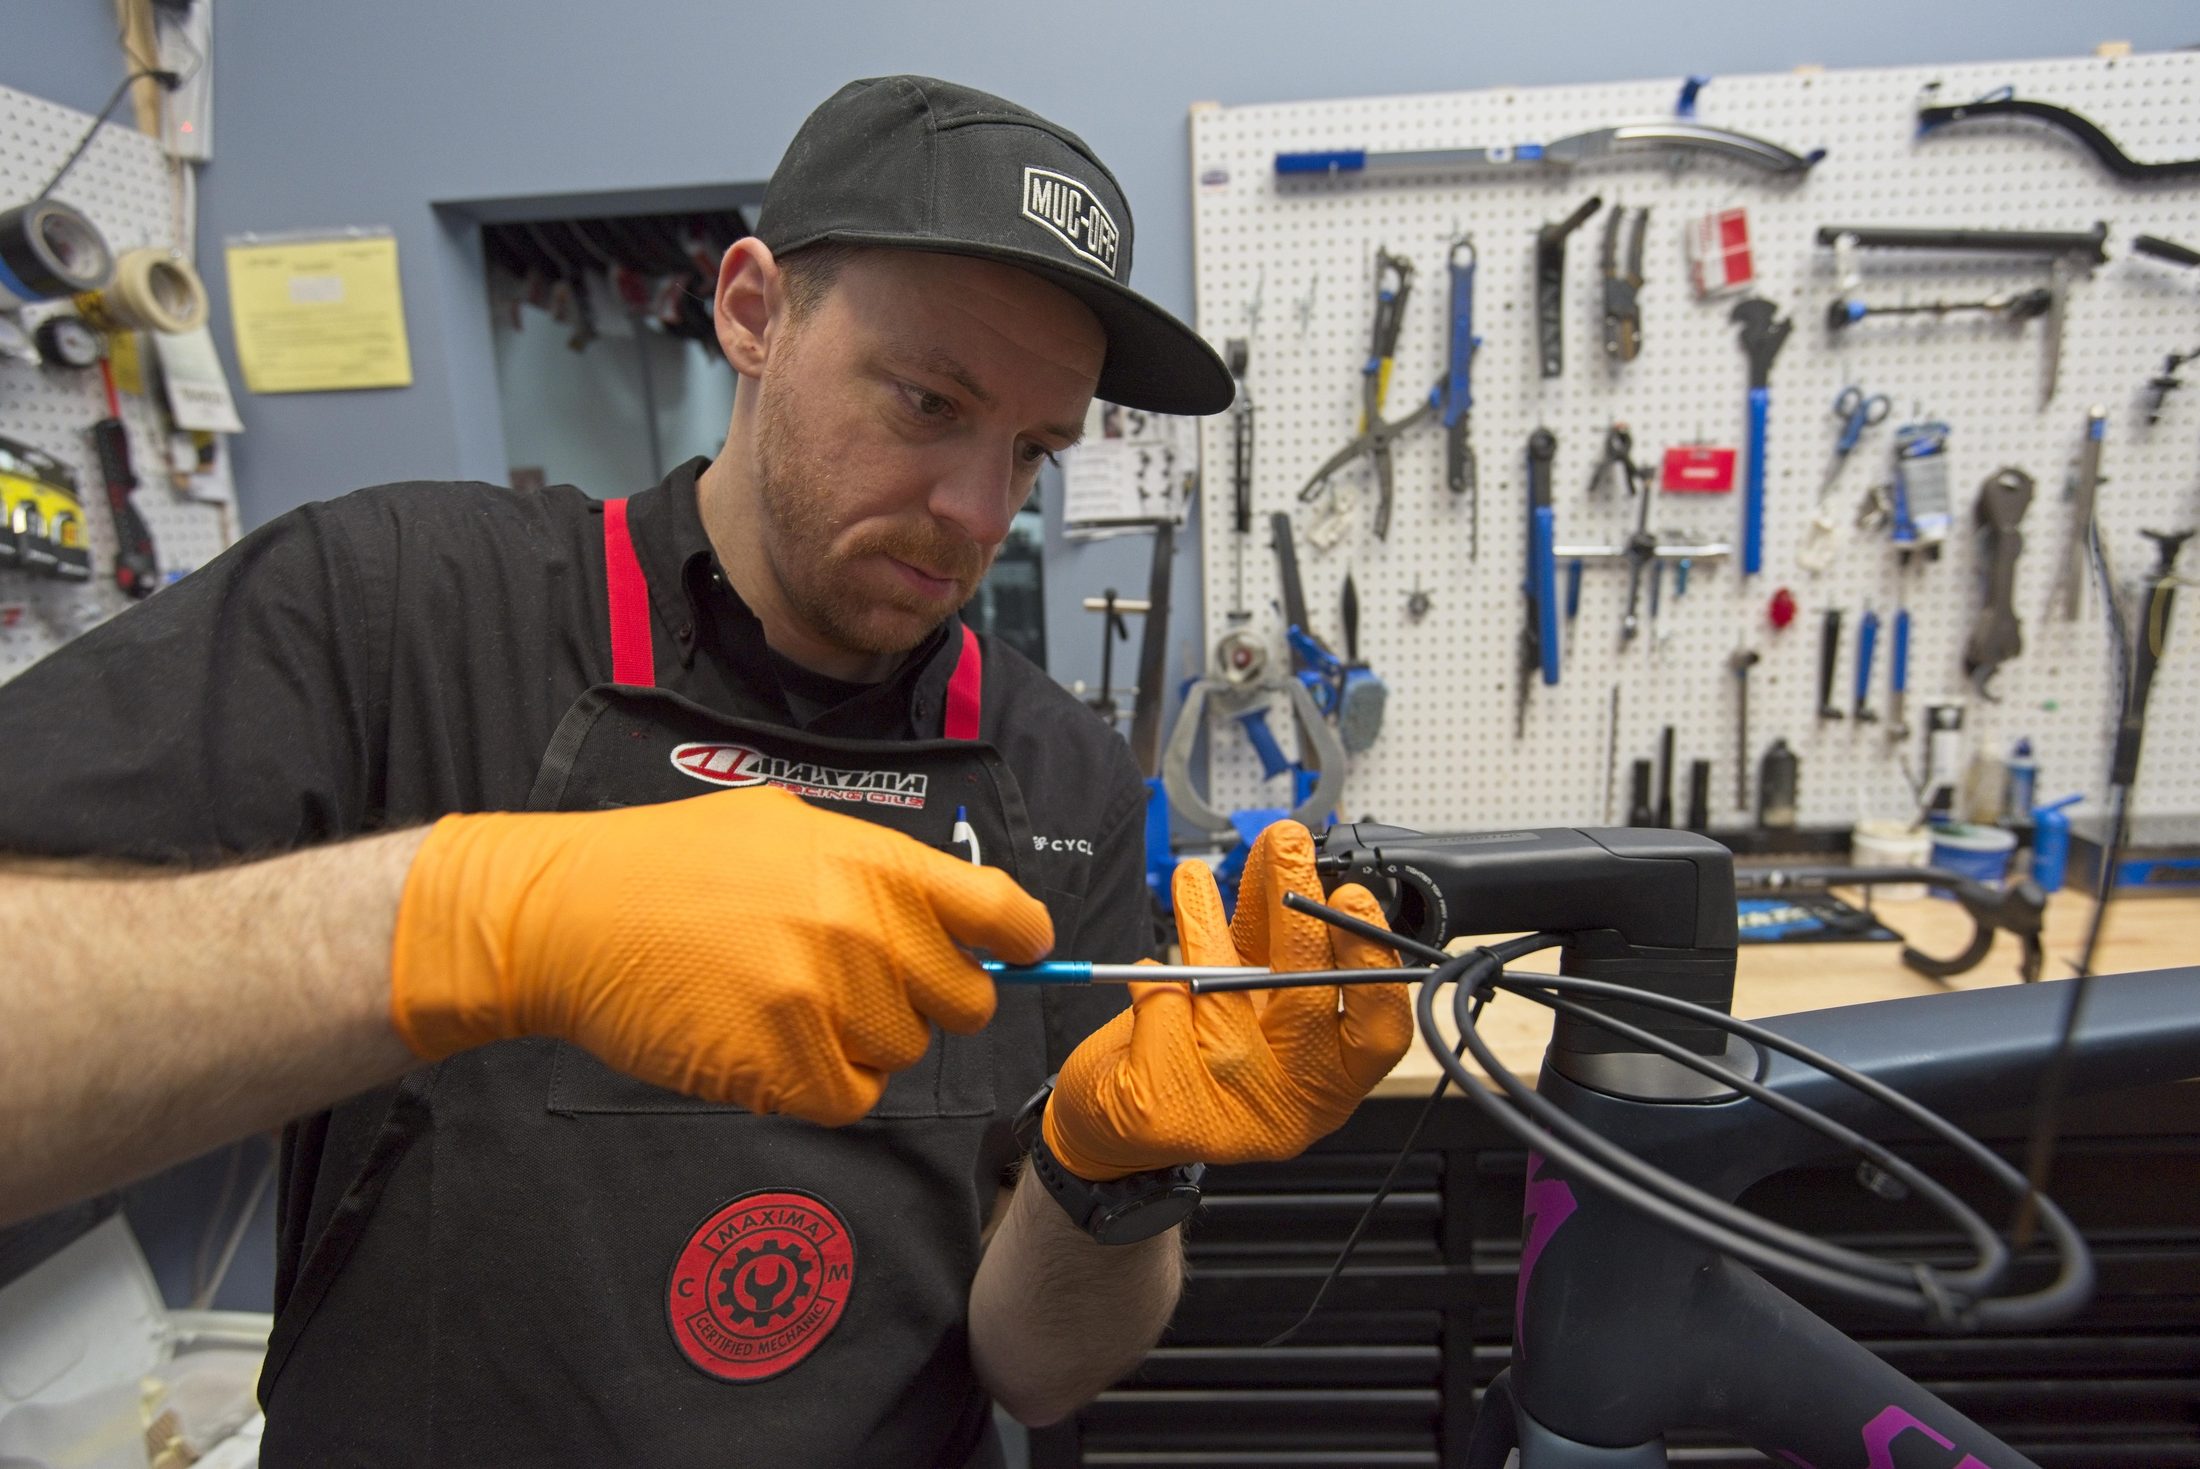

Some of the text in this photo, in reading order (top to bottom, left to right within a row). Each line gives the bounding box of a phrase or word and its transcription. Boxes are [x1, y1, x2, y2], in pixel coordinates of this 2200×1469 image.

[1032, 178, 1116, 261] MUC-OFF
[867, 792, 925, 809] OILS
[717, 1210, 821, 1246] MAXIMA
[678, 1263, 849, 1298] C M
[696, 1303, 826, 1356] CERTIFIED MECHANIC
